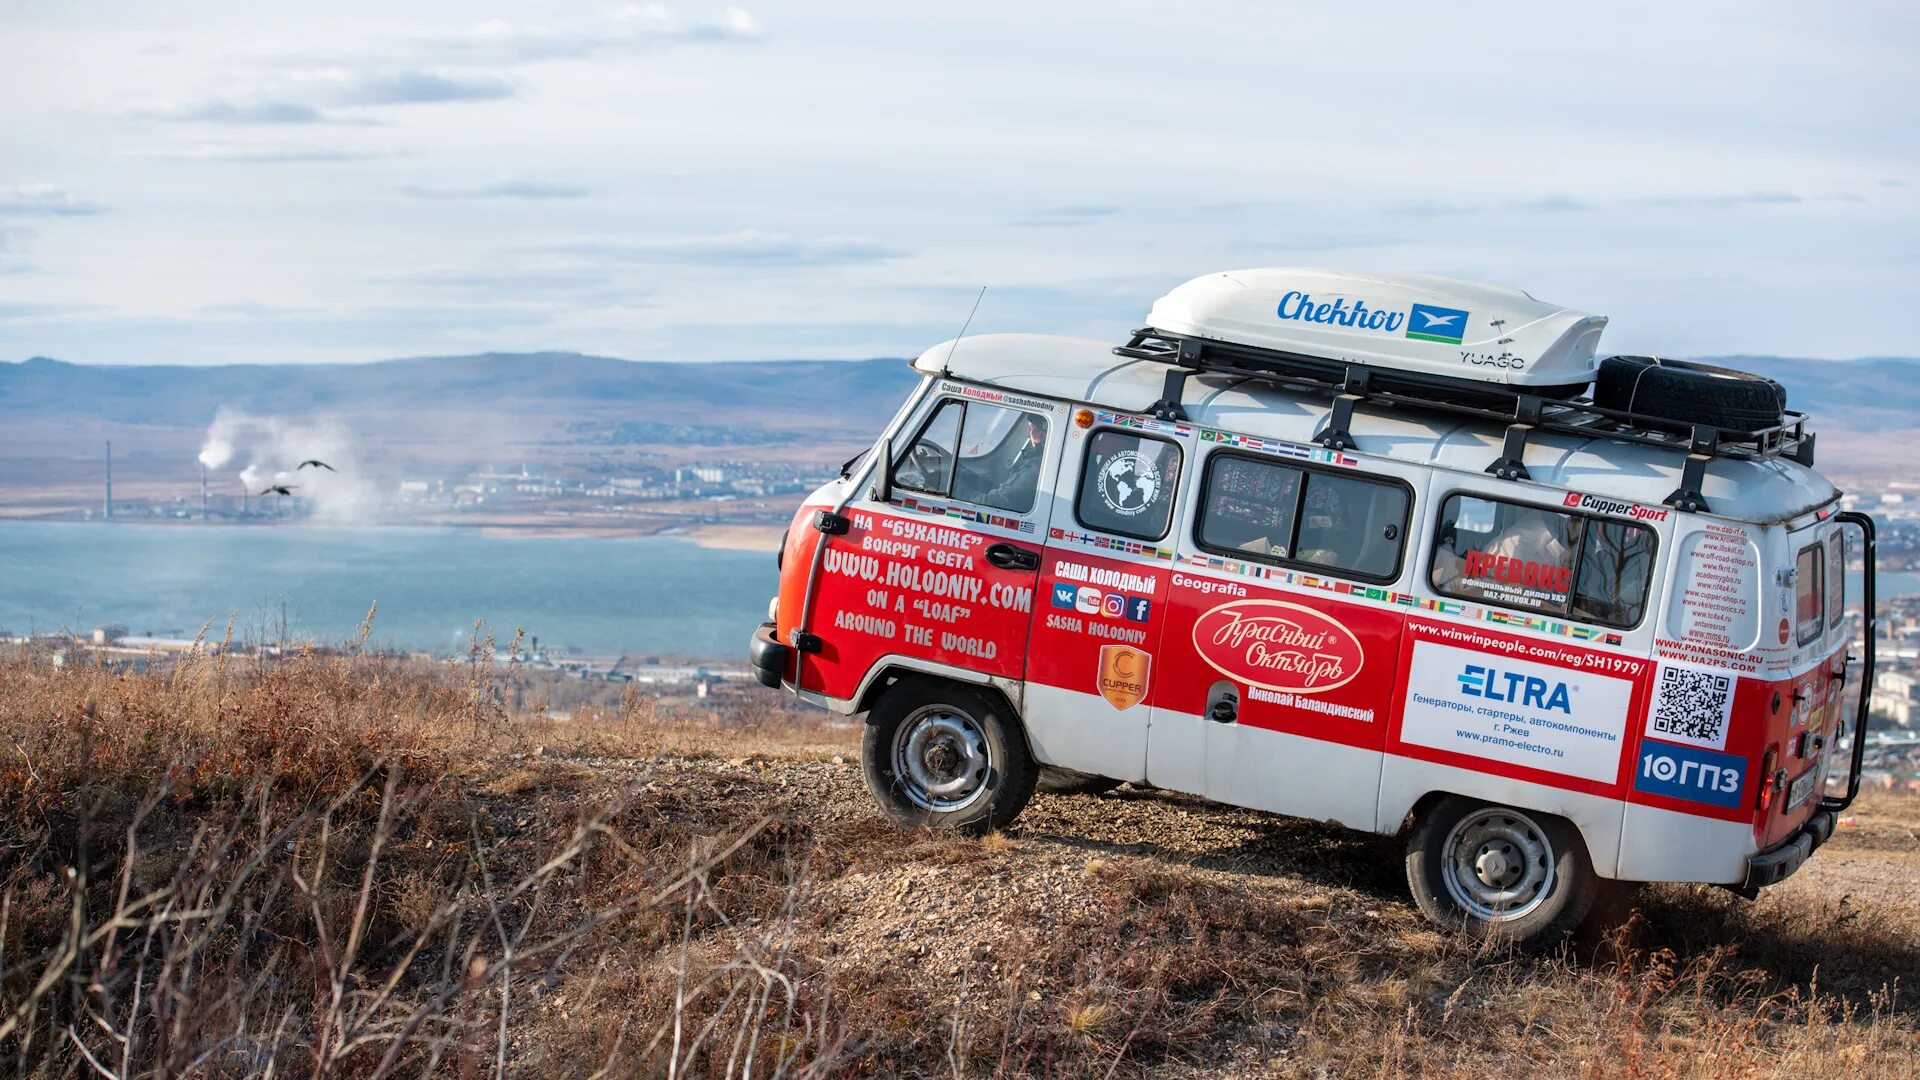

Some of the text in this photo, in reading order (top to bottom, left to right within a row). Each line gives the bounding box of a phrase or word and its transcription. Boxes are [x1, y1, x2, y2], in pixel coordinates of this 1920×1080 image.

[1277, 290, 1404, 332] Chekhov
[1460, 351, 1525, 369] YUAGO
[941, 382, 1055, 412] Саша Холодный @sashaholodniy
[853, 514, 873, 531] НА
[1581, 495, 1668, 521] CupperSport
[862, 536, 973, 571] ВОКРУГ СВЕТА
[1690, 551, 1754, 567] www.off-road-shop.ru
[824, 548, 1032, 613] WWW.HOLODNIY.COM
[1055, 561, 1156, 595] САША ХОЛОДНЫЙ
[1172, 573, 1247, 597] Geografia
[1464, 549, 1572, 593] ПРЕВОКС
[867, 589, 888, 607] ON
[894, 595, 905, 613] A
[1462, 578, 1566, 603] официальный дилер УАЗ
[1483, 589, 1541, 607] UAZ-PREVOX.RU
[1685, 590, 1746, 605] www.cupper-shop.ru
[1682, 600, 1745, 615] www.vkelectronics.ru
[834, 610, 997, 659] AROUND THE WORLD
[1046, 613, 1147, 645] SASHA HOLODNIY
[1213, 610, 1328, 650] Красный
[1408, 621, 1646, 677] www.winwinpeople.com/reg/SH1979/
[1655, 638, 1764, 664] WWW.PANASONIC.RU
[1246, 641, 1344, 687] Октябрь
[1103, 678, 1142, 693] CUPPER
[1457, 664, 1572, 714] ELTRA
[1248, 685, 1293, 706] Николай
[1295, 695, 1375, 723] Баландинский
[1413, 693, 1617, 742] Генераторы, стартеры, автокомпоненты
[1456, 729, 1564, 758] www.pramo-electro.ru
[1494, 724, 1530, 738] г. Ржев
